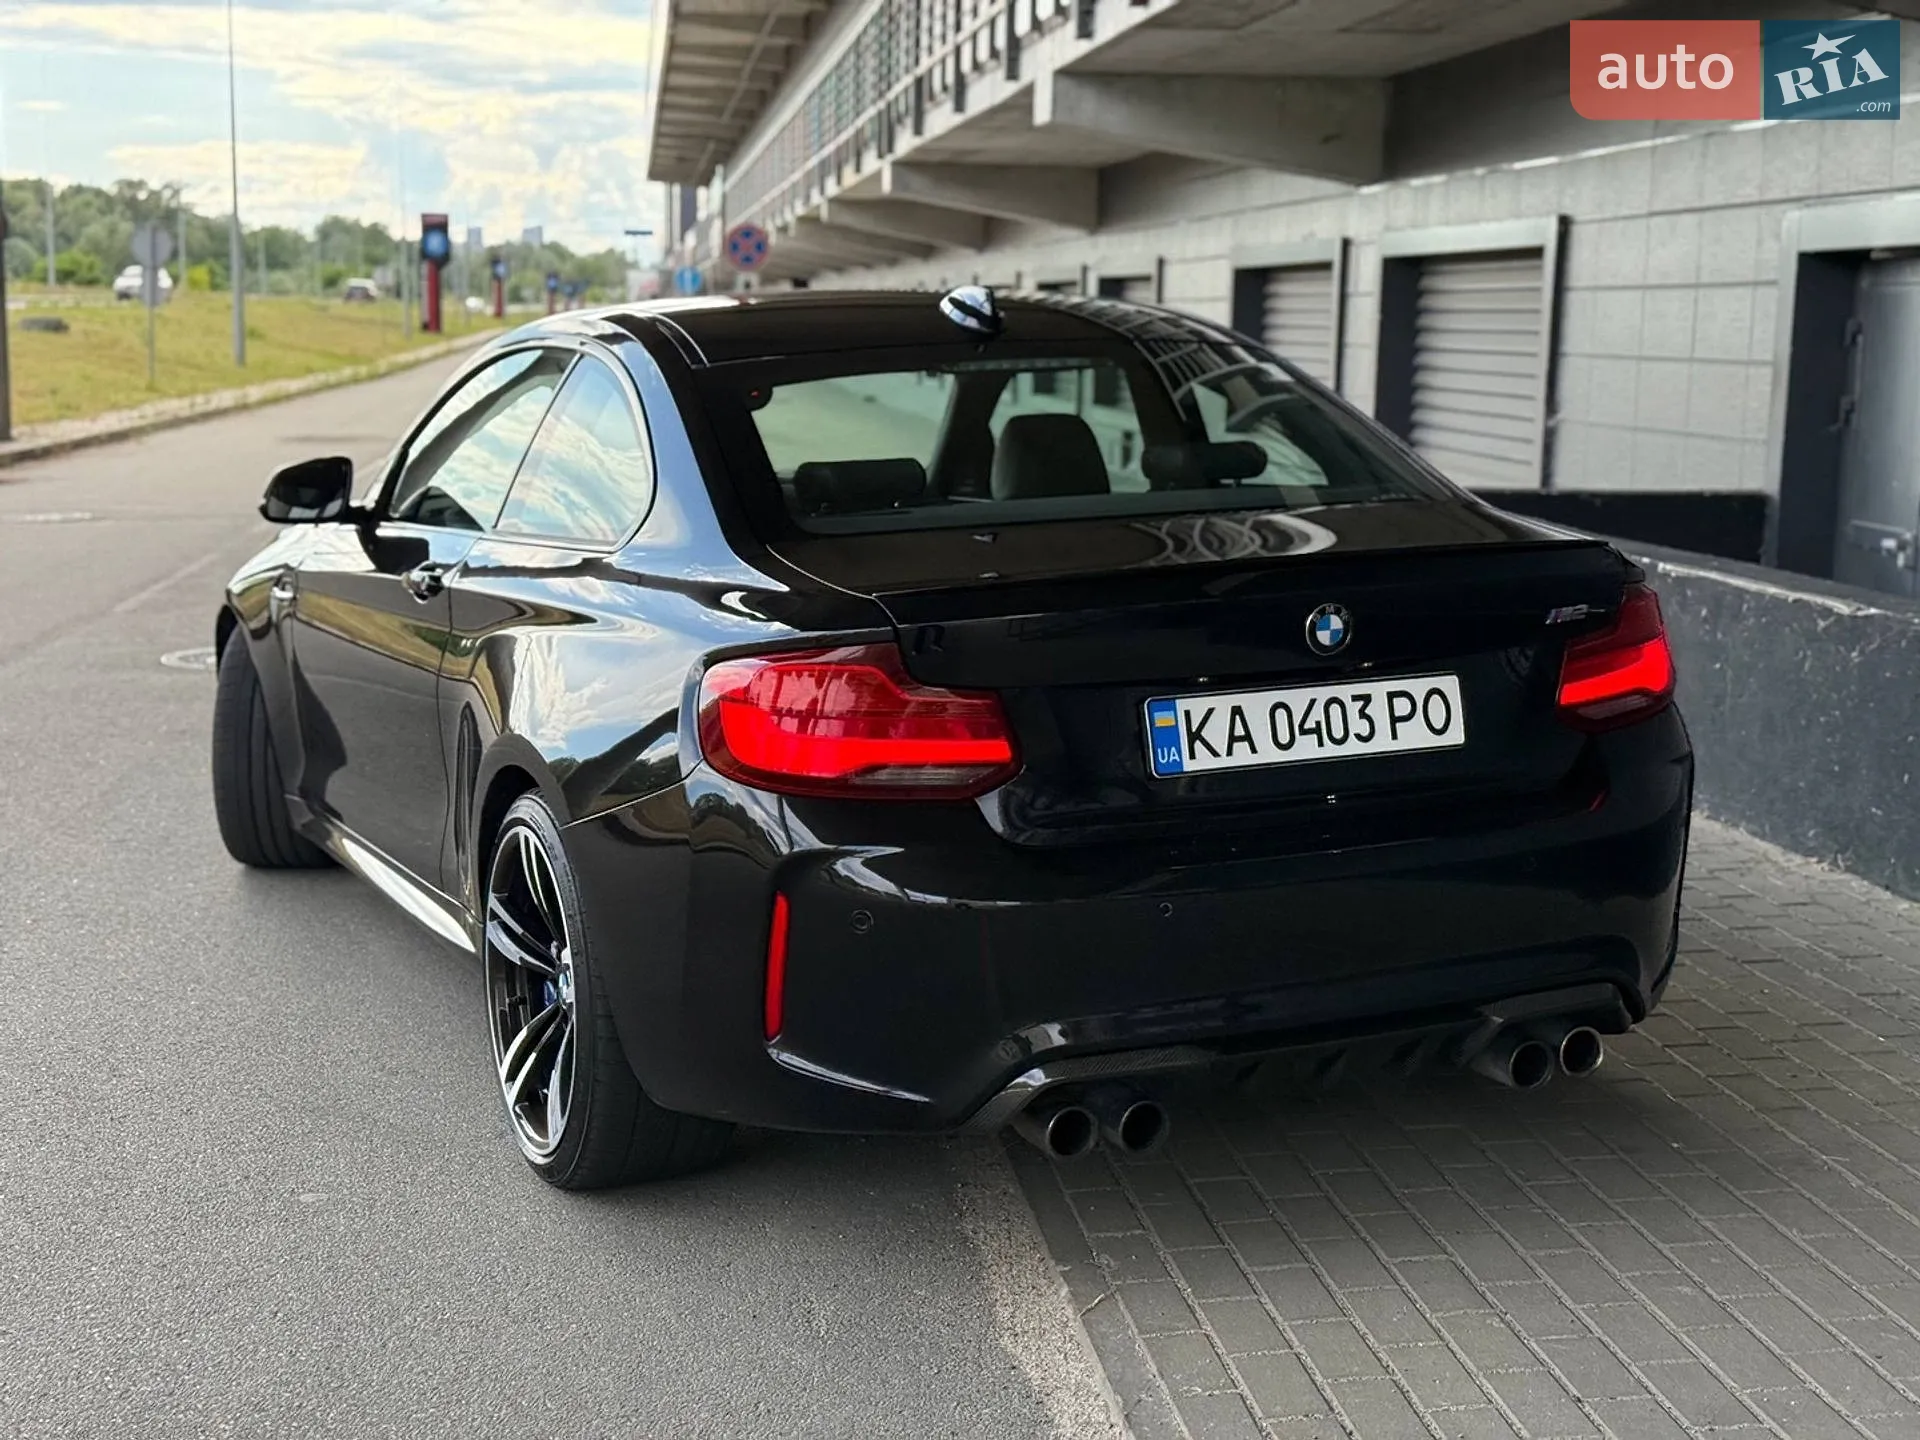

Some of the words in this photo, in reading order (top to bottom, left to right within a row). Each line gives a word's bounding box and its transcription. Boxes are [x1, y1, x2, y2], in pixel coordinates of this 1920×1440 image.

[1184, 705, 1258, 761] KA
[1269, 692, 1376, 751] 0403
[1386, 686, 1452, 741] PO
[1158, 747, 1180, 764] UA
